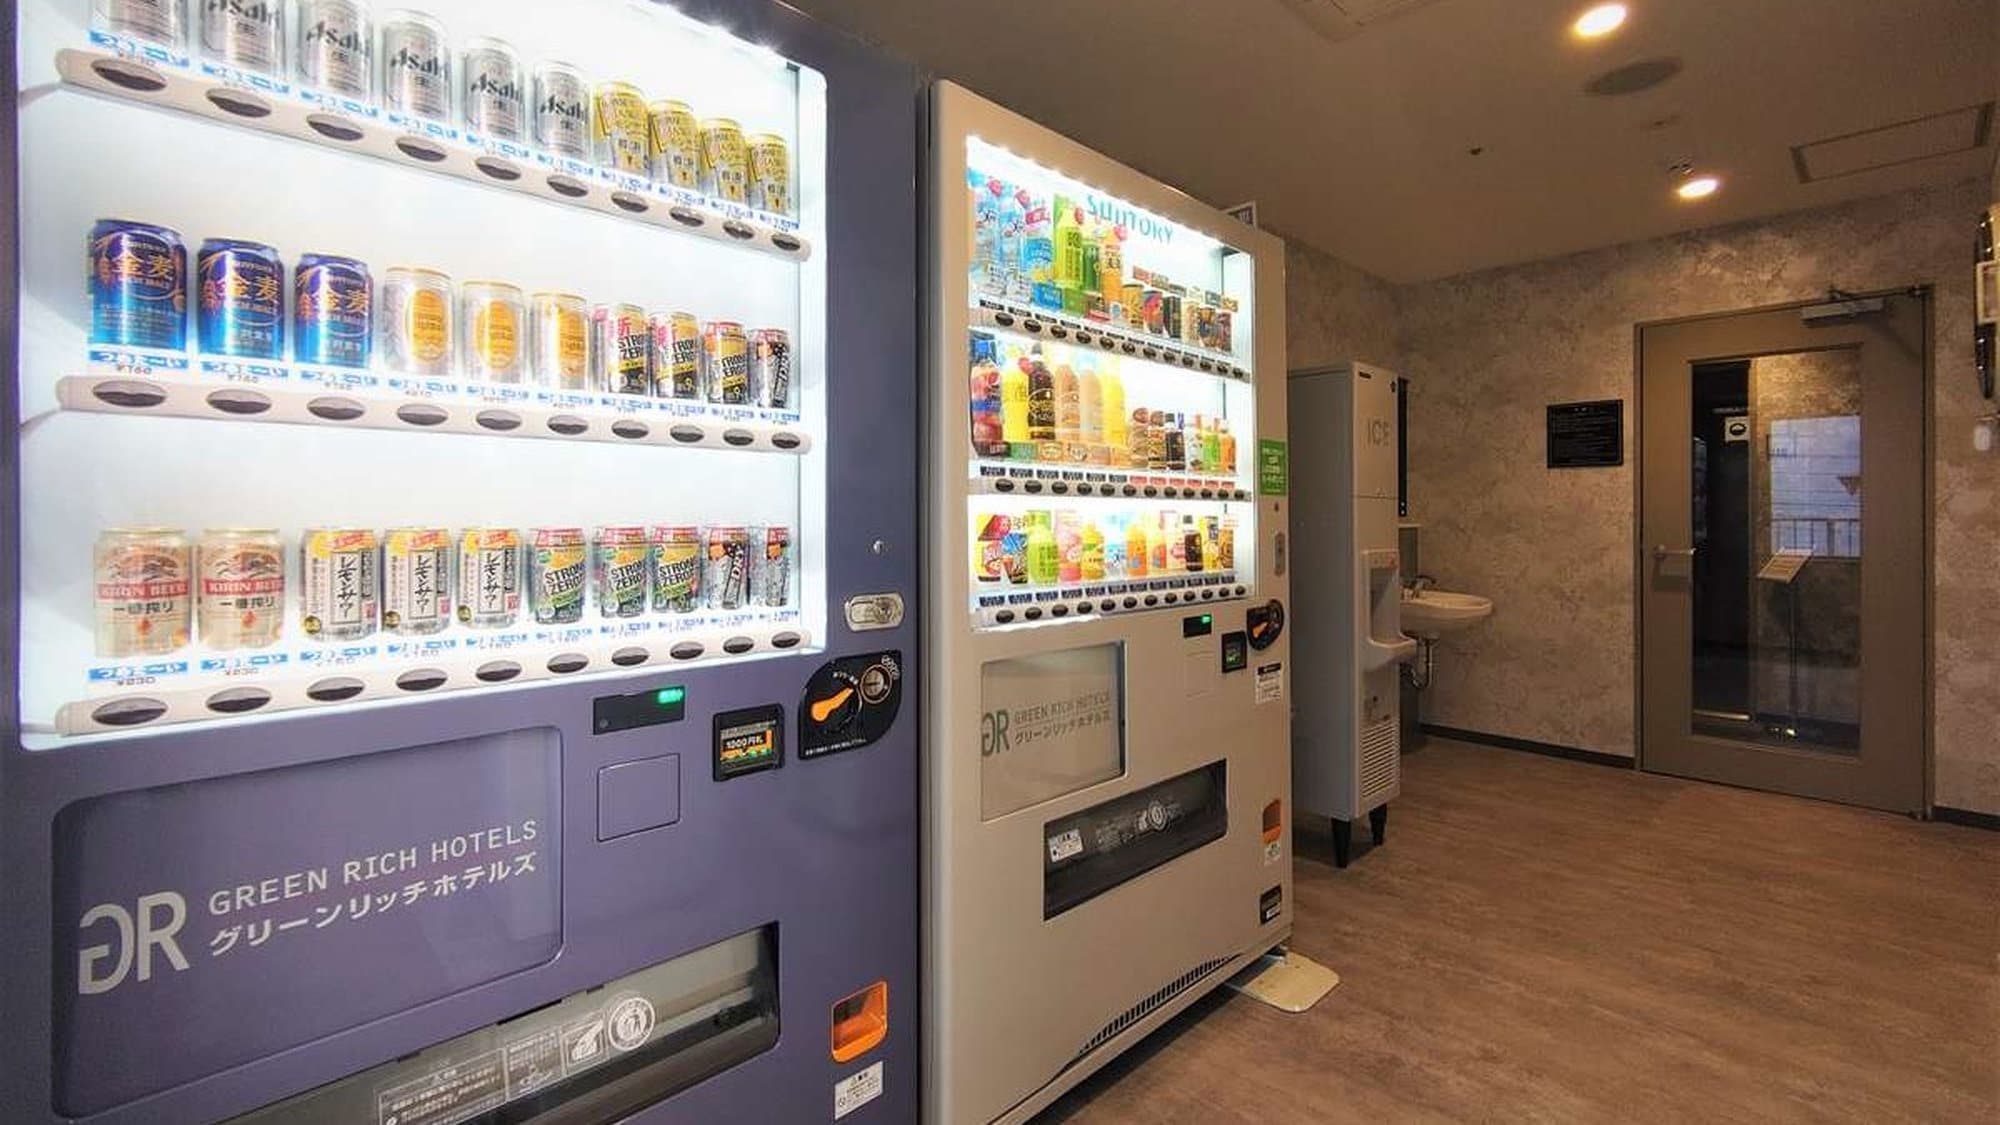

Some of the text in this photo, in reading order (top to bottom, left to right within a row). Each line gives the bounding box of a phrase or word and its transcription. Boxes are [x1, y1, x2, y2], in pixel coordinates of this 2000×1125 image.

[306, 21, 370, 57] Asahi
[390, 48, 449, 80] Asahi
[112, 252, 176, 281] 金麦
[543, 562, 586, 585] STRON
[611, 560, 647, 580] STRON
[658, 557, 696, 577] STRON
[208, 820, 538, 917] GREEN RICH HOTELS
[209, 852, 538, 956] グリーンリッチホテルズ
